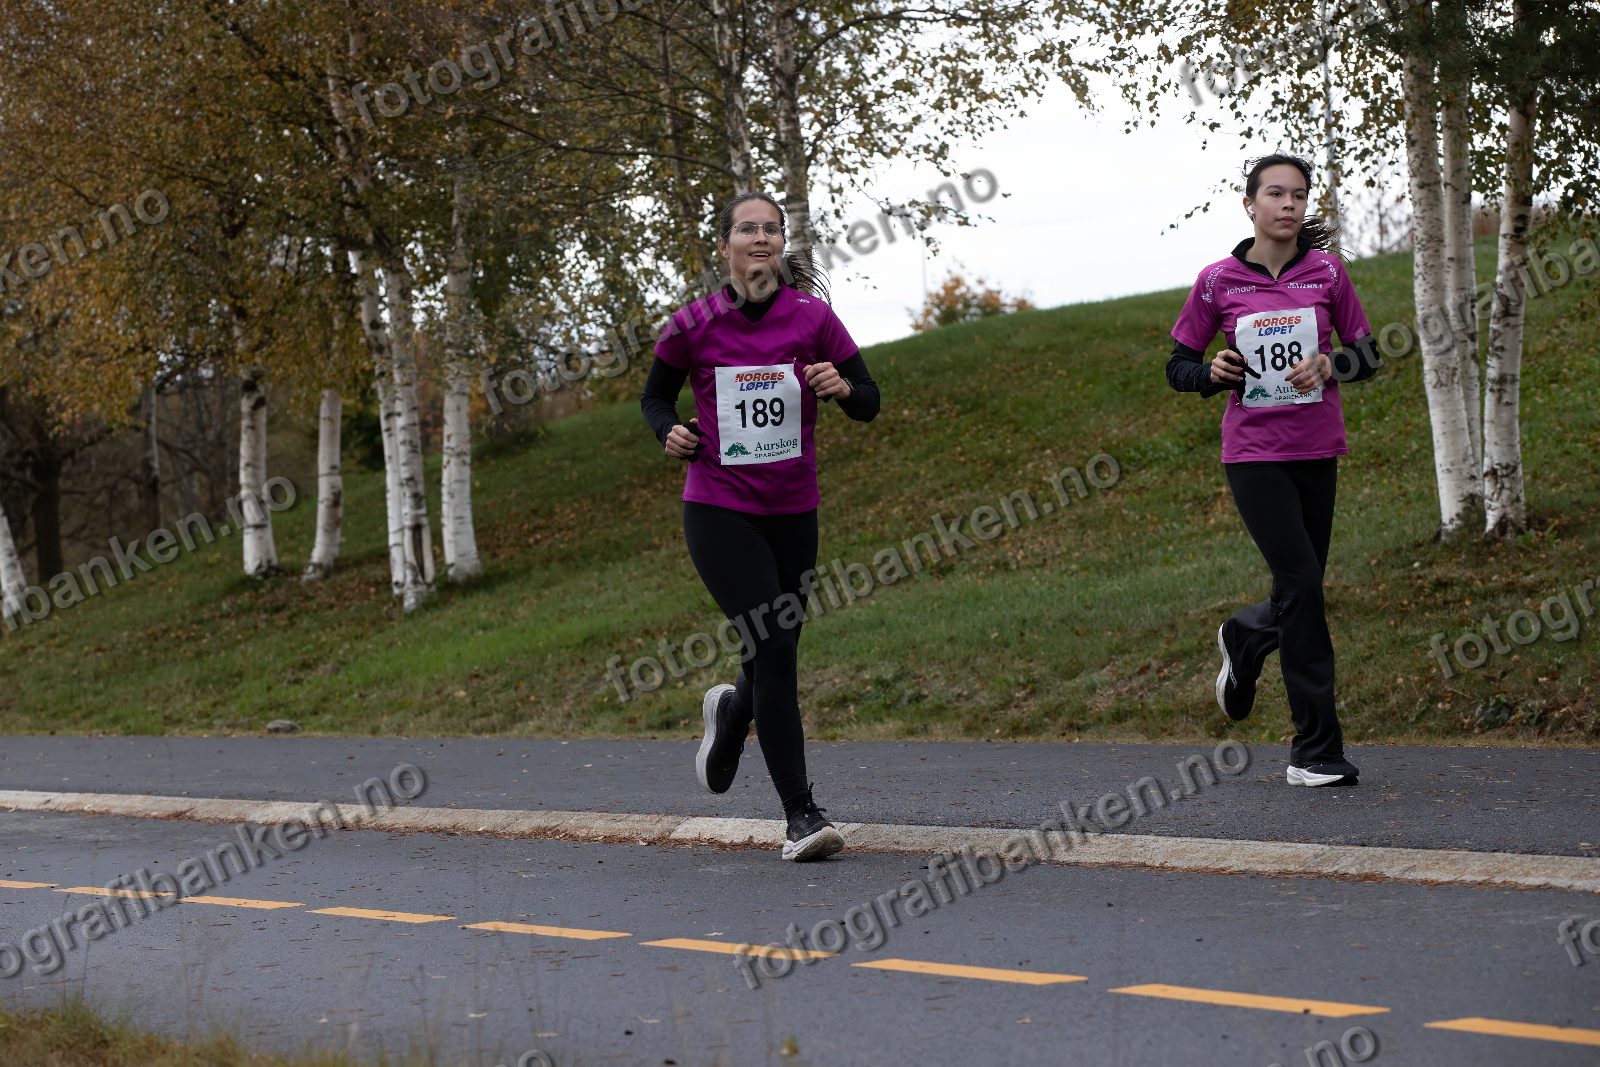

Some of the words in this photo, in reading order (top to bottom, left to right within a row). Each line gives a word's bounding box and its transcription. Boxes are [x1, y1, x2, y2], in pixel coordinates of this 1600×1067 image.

[1226, 285, 1256, 297] johaug
[1251, 316, 1302, 329] NORGES
[1258, 325, 1295, 337] LØPET
[1254, 341, 1303, 372] 188
[735, 371, 785, 382] NORGES
[740, 381, 778, 391] LØPET
[735, 397, 785, 428] 189
[754, 438, 798, 452] Aurskog
